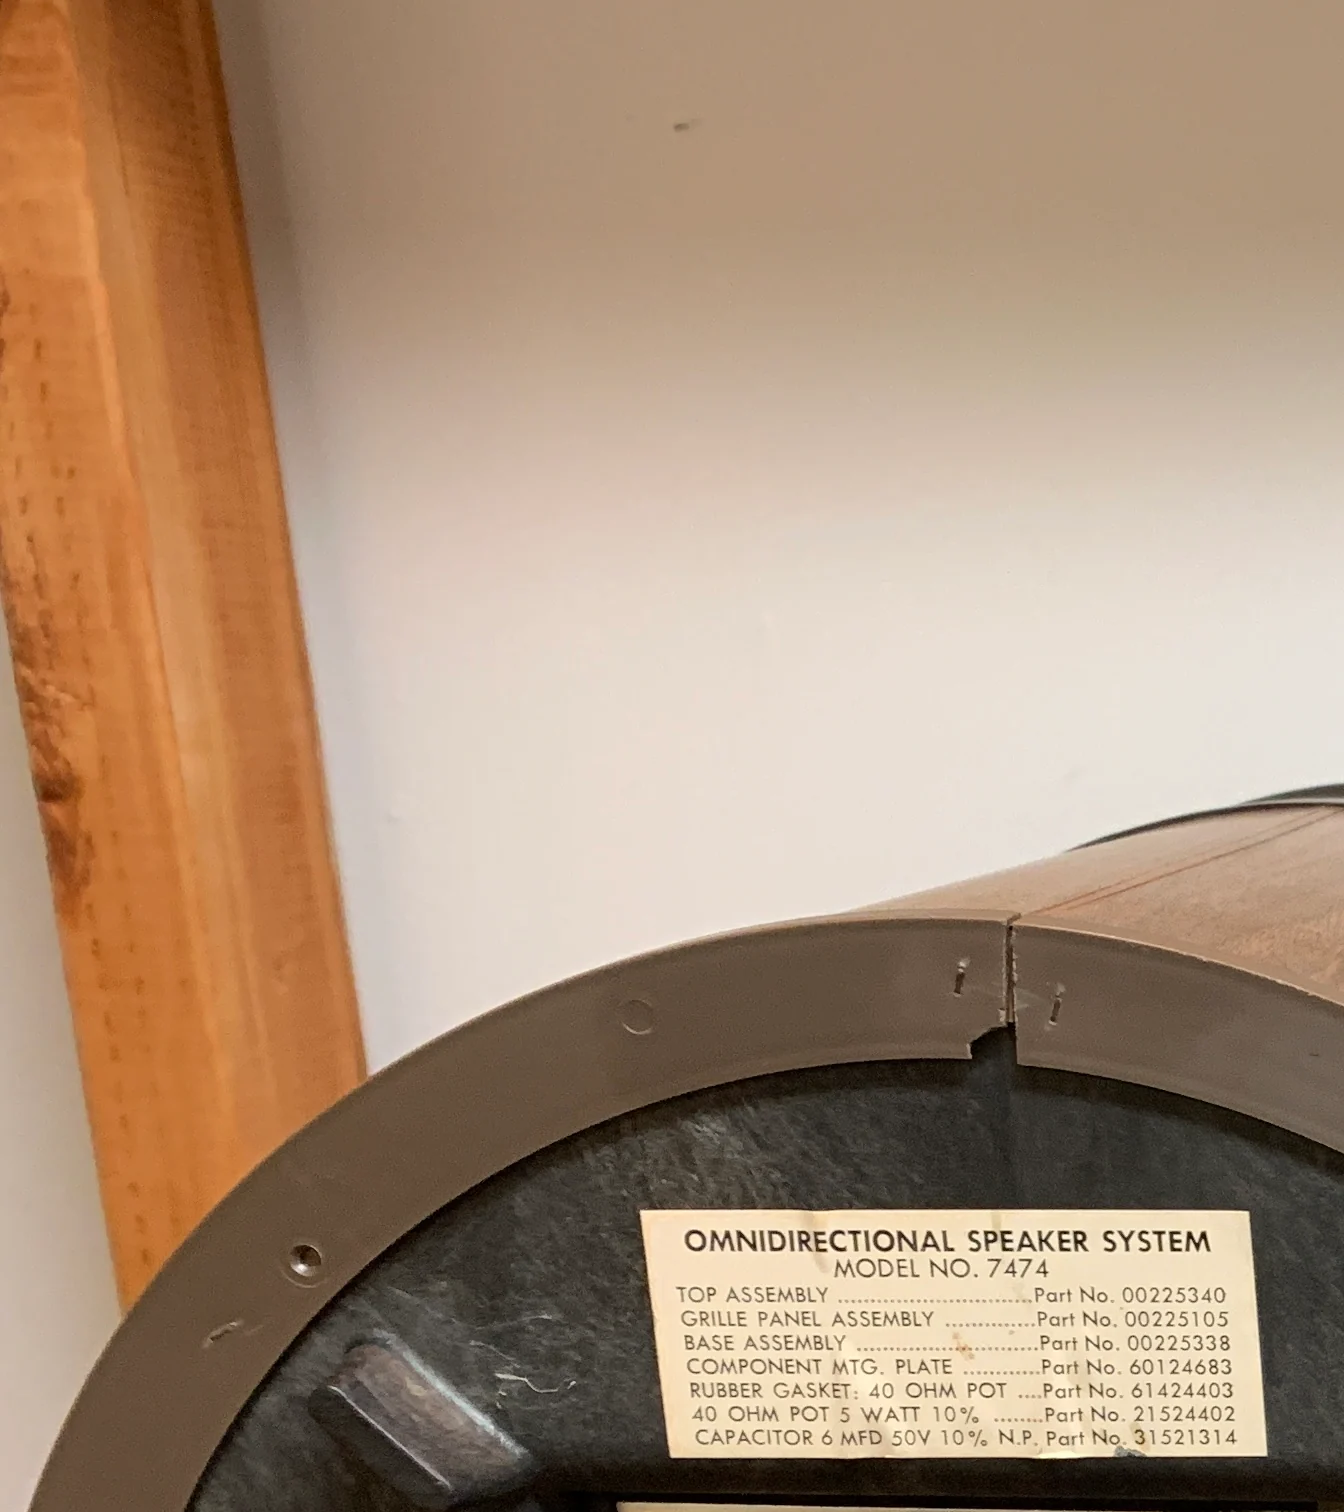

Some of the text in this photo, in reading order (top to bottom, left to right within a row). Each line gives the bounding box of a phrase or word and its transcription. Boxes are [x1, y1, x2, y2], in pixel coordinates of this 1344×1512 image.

[684, 1230, 1211, 1252] OMNIDIRECTIONAL SPEAKER SYSTEM
[834, 1258, 1049, 1278] MODEL NO. 7474
[676, 1287, 1226, 1303] TOP ASSEMBLY Part No. 00225340
[681, 1311, 1229, 1327] GRILLE PANEL ASSEMBLY Part No. 00225105
[684, 1335, 1231, 1351] BASE ASSEMBLY Part No. 00225338
[687, 1358, 1232, 1375] COMPONENT MTG. PLATE Part No. 60124683
[690, 1382, 1234, 1399] RUBBER GASKET: 40 OHM POT Part No. 61424403
[692, 1406, 1235, 1423] 40 OHM POT 5 WATT 10% Part No. 21524402
[695, 1429, 1237, 1446] CAPACITOR 6 MFD 50V 10% N.P. Part No. 31521314
